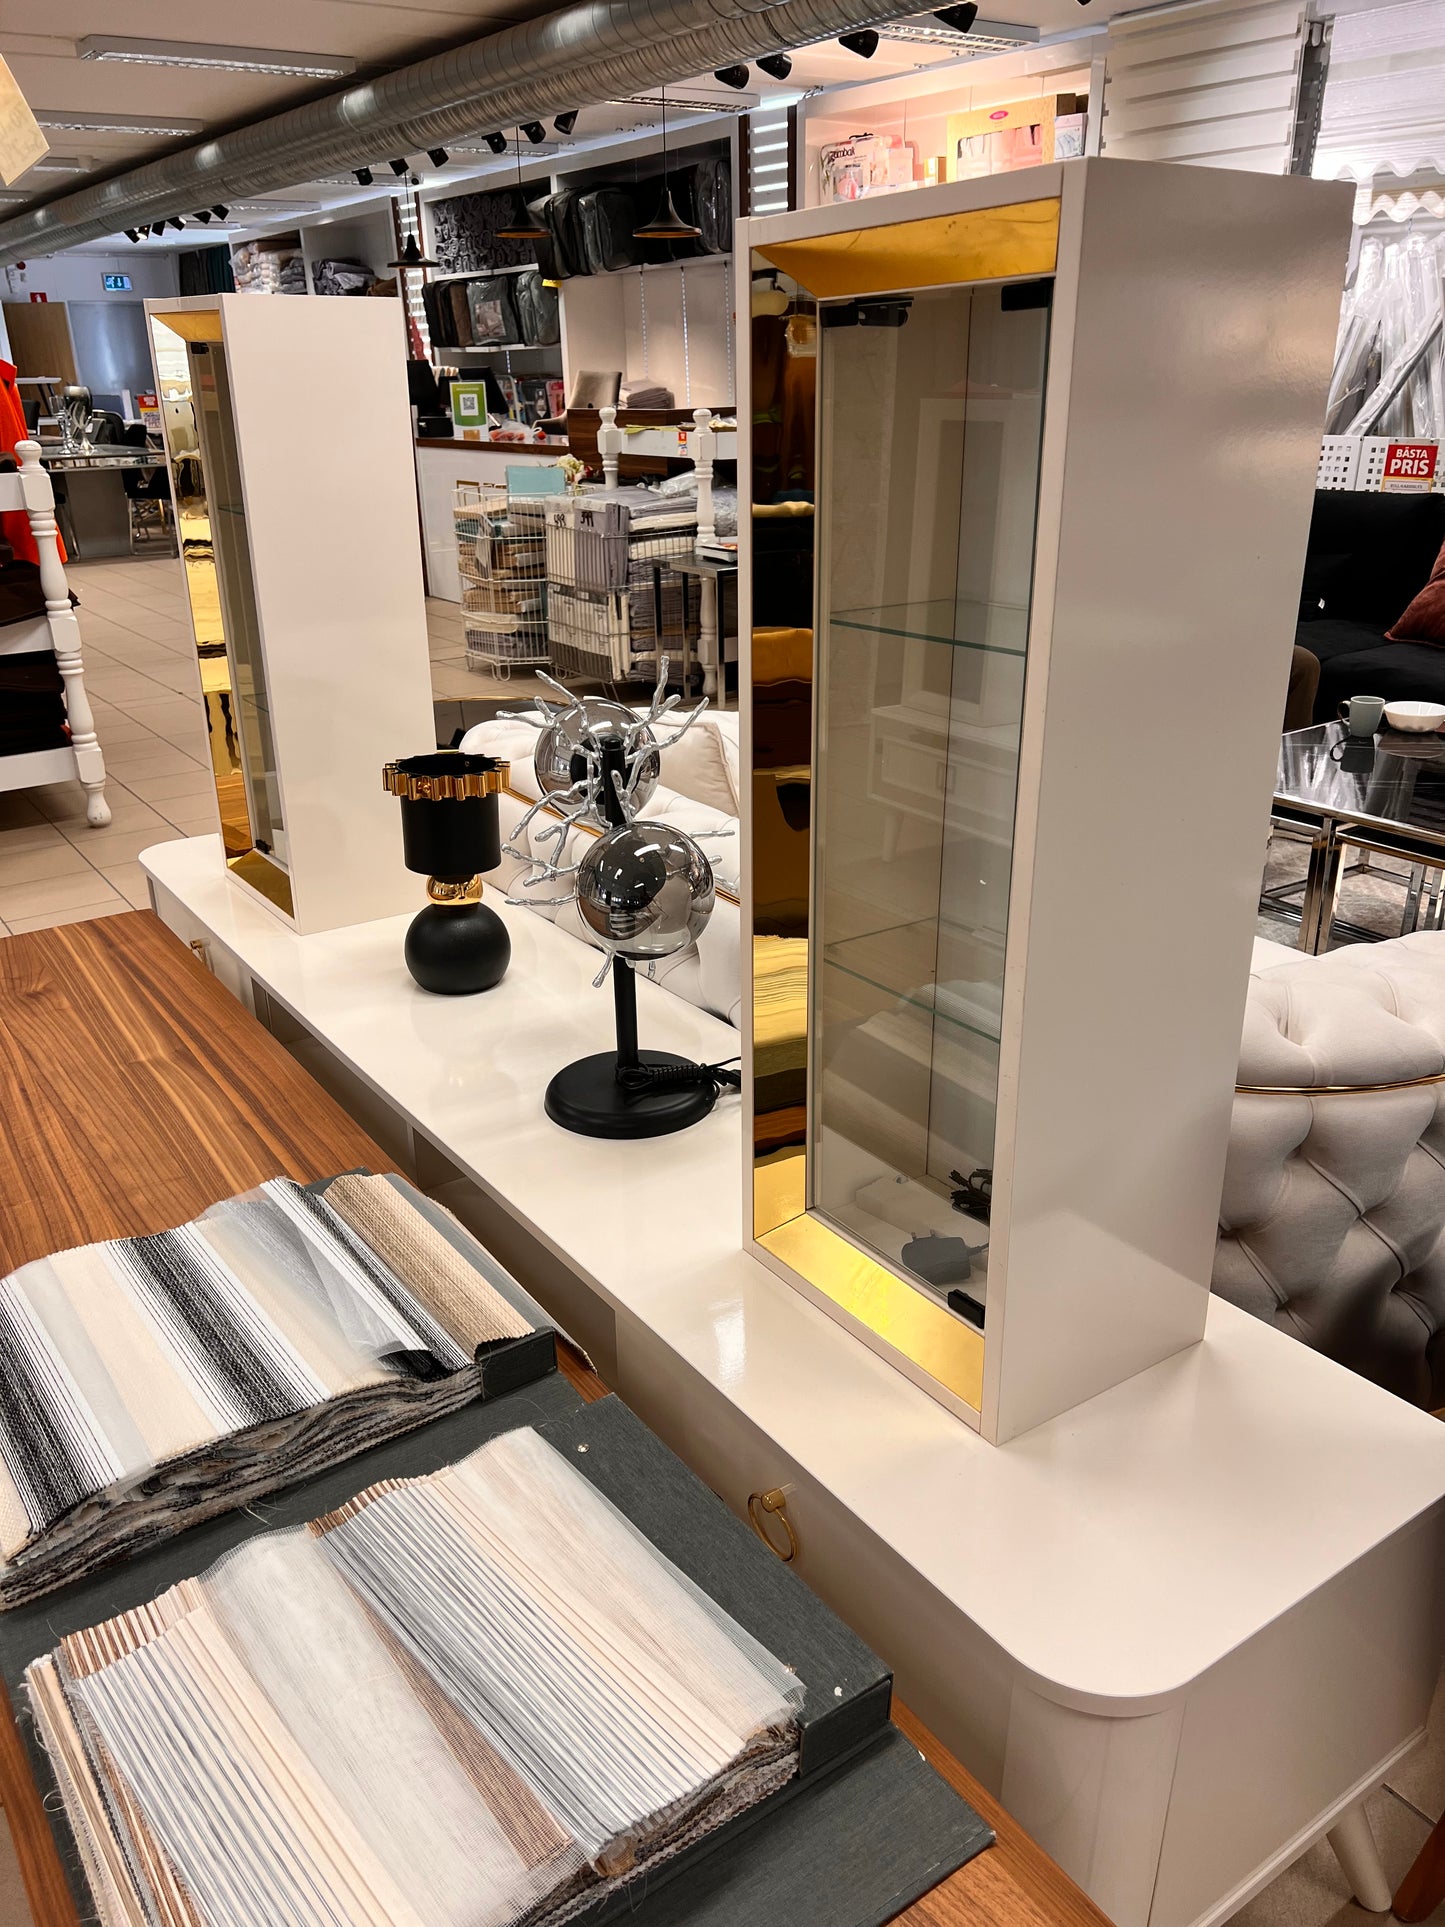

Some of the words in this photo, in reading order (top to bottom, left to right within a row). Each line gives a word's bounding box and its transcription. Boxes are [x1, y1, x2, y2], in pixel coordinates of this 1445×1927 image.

[1396, 446, 1428, 459] BÄSTA
[1390, 458, 1429, 475] PRIS
[580, 511, 594, 527] 399
